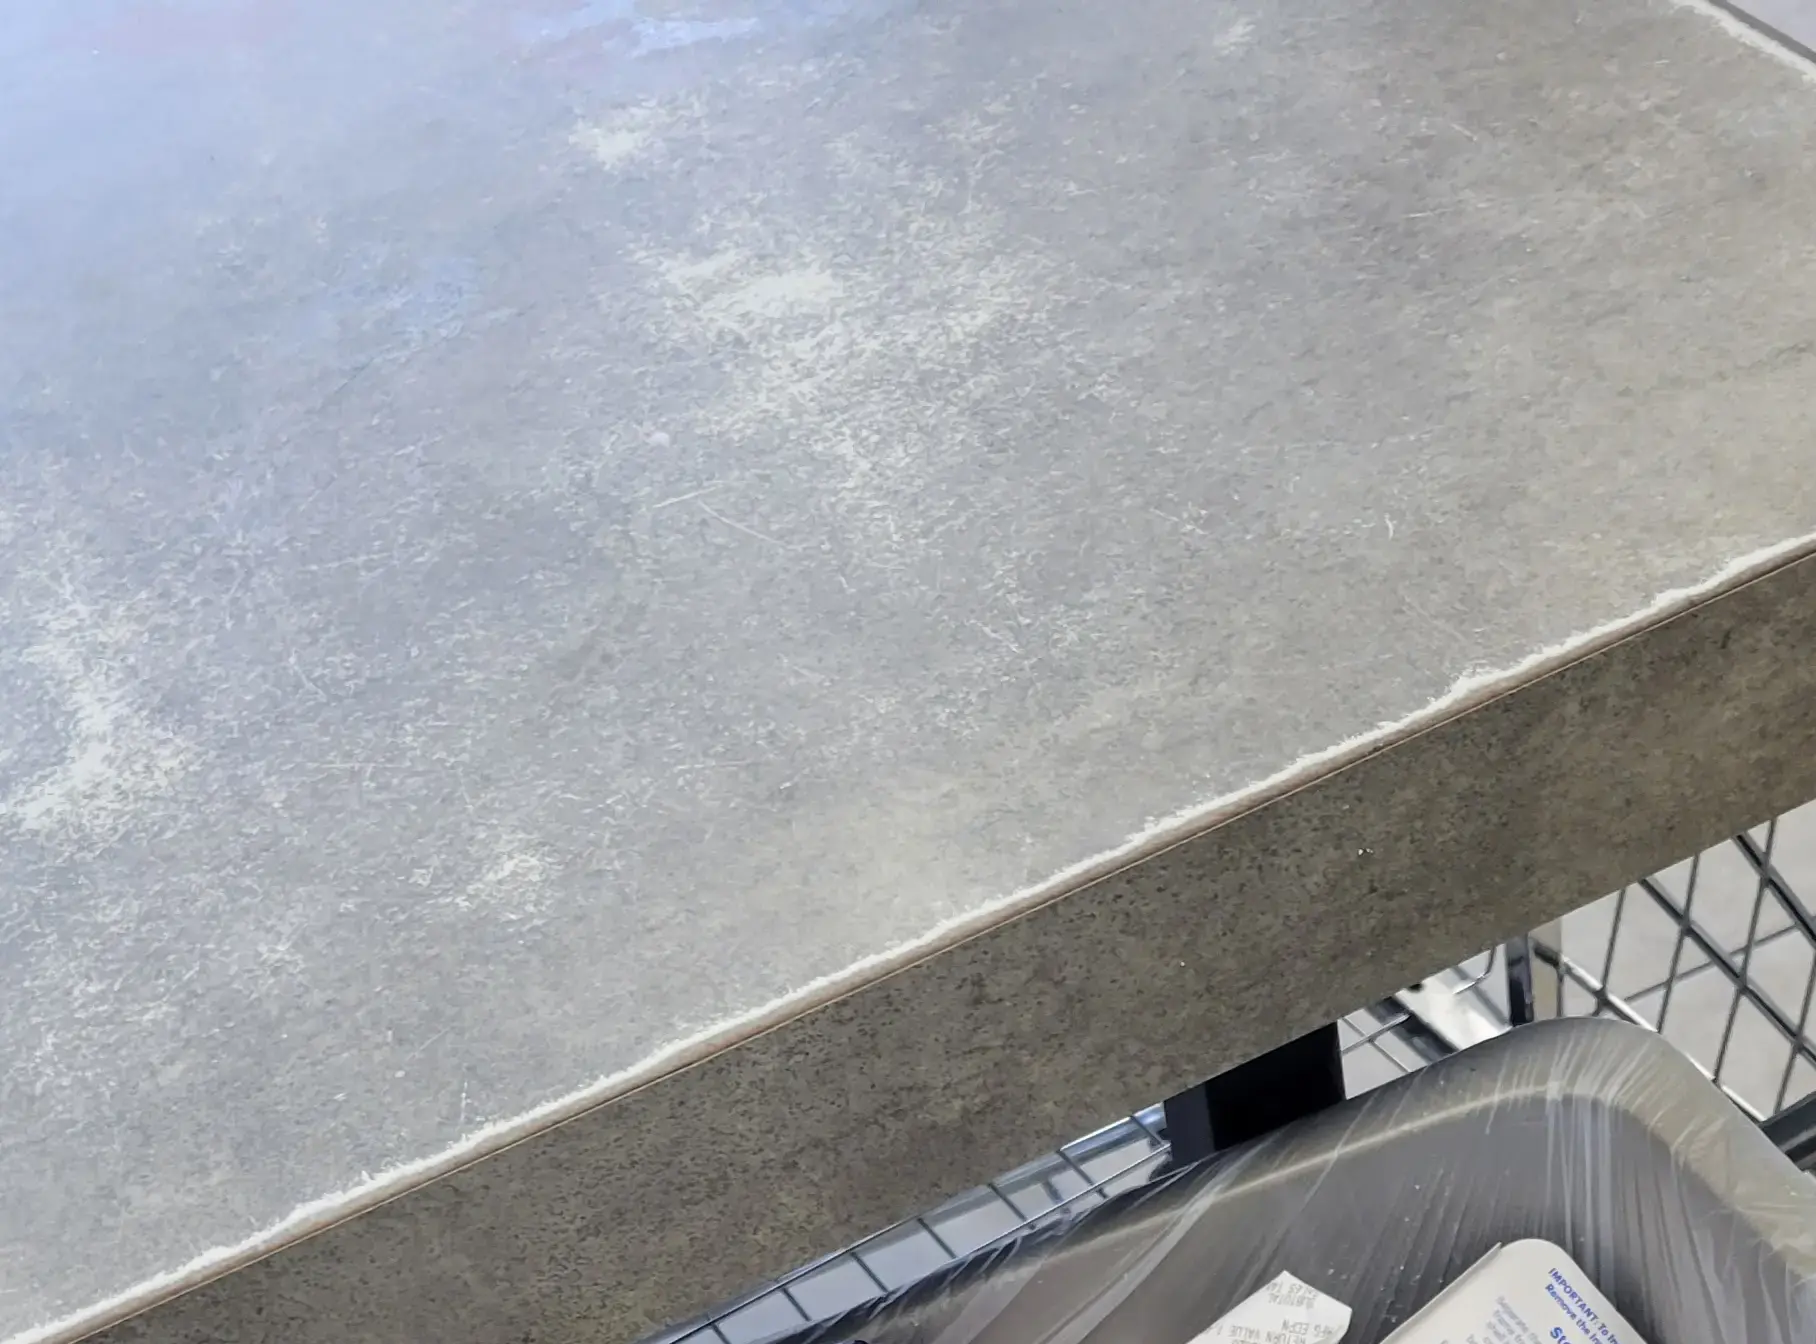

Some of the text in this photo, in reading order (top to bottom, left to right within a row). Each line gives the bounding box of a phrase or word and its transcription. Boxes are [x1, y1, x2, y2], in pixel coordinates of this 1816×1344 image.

[1545, 1282, 1581, 1322] Remove
[1575, 1317, 1593, 1337] the
[1548, 1266, 1598, 1326] IMPORTANT:
[1596, 1323, 1612, 1338] To
[1230, 1325, 1261, 1341] VALUE
